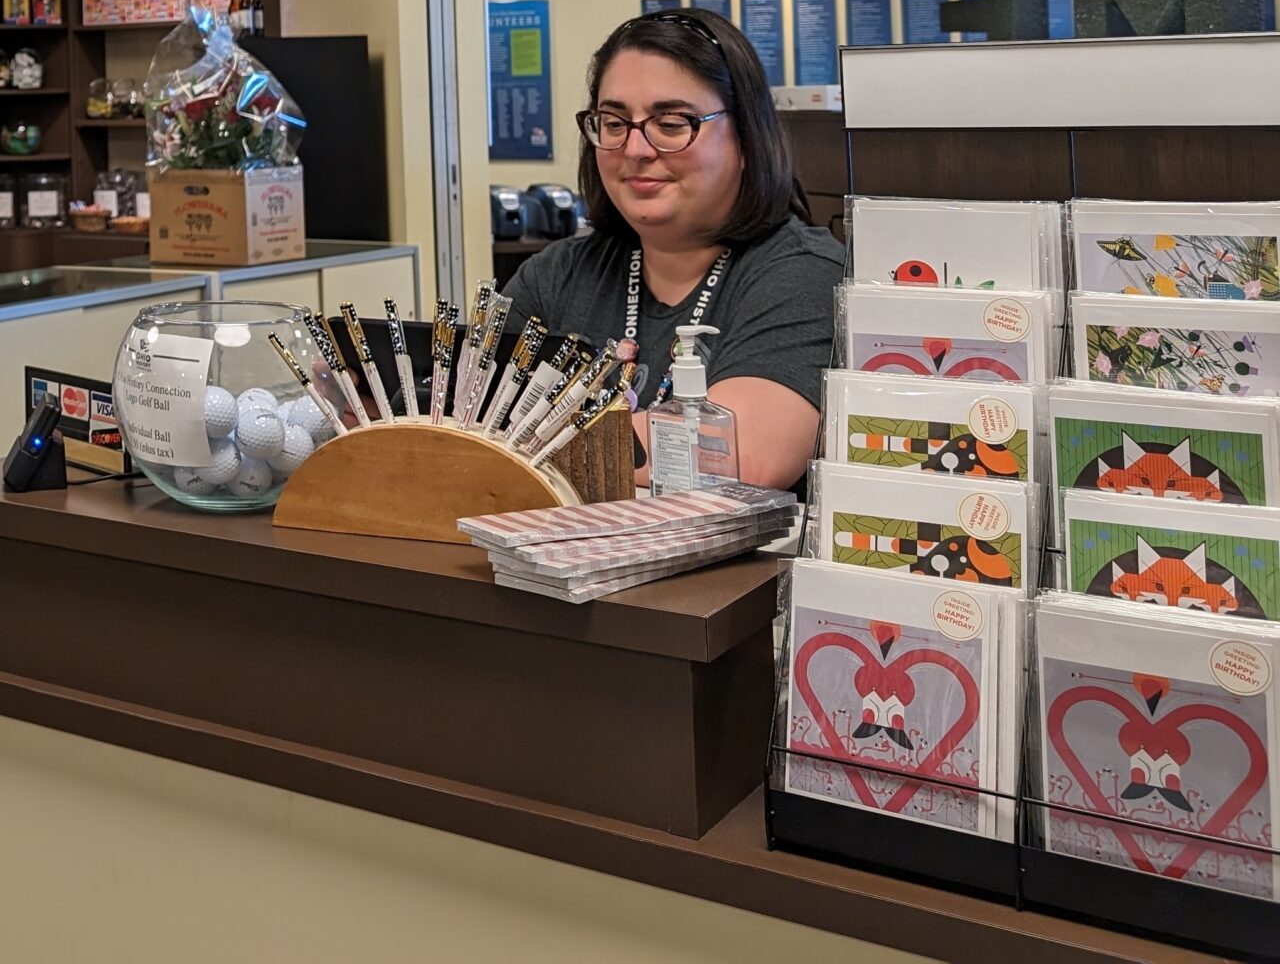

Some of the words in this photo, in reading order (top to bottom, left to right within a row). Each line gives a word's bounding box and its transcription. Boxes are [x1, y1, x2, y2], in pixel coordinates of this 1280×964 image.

[489, 15, 541, 26] UNTEERS
[707, 248, 732, 287] OHIO
[625, 249, 642, 338] ONNECTION
[690, 290, 712, 326] HIST
[1000, 304, 1019, 313] INSIDE
[987, 318, 1022, 334] BIRTHDAY!
[995, 314, 1018, 325] HAPPY
[136, 352, 151, 363] OHIO
[146, 381, 191, 399] Connection
[96, 402, 115, 417] VISA
[126, 390, 138, 405] Logo
[138, 395, 152, 408] Golf
[154, 398, 170, 411] Ball
[978, 404, 992, 438] BIRTHDAY!
[987, 409, 997, 432] HAPPY
[1001, 410, 1009, 428] INSIDE
[154, 430, 171, 443] Ball
[157, 446, 175, 459] tax)
[967, 496, 984, 530] BIRTHDAY!
[978, 504, 989, 526] HAPPY
[992, 512, 1001, 531] INSIDE
[950, 598, 971, 609] INSIDE
[936, 612, 975, 632] BIRTHDAY!
[944, 608, 970, 622] HAPPY
[1233, 648, 1257, 662] INSIDE
[1215, 662, 1260, 687] BIRTHDAY!
[1224, 660, 1255, 676] HAPPY
